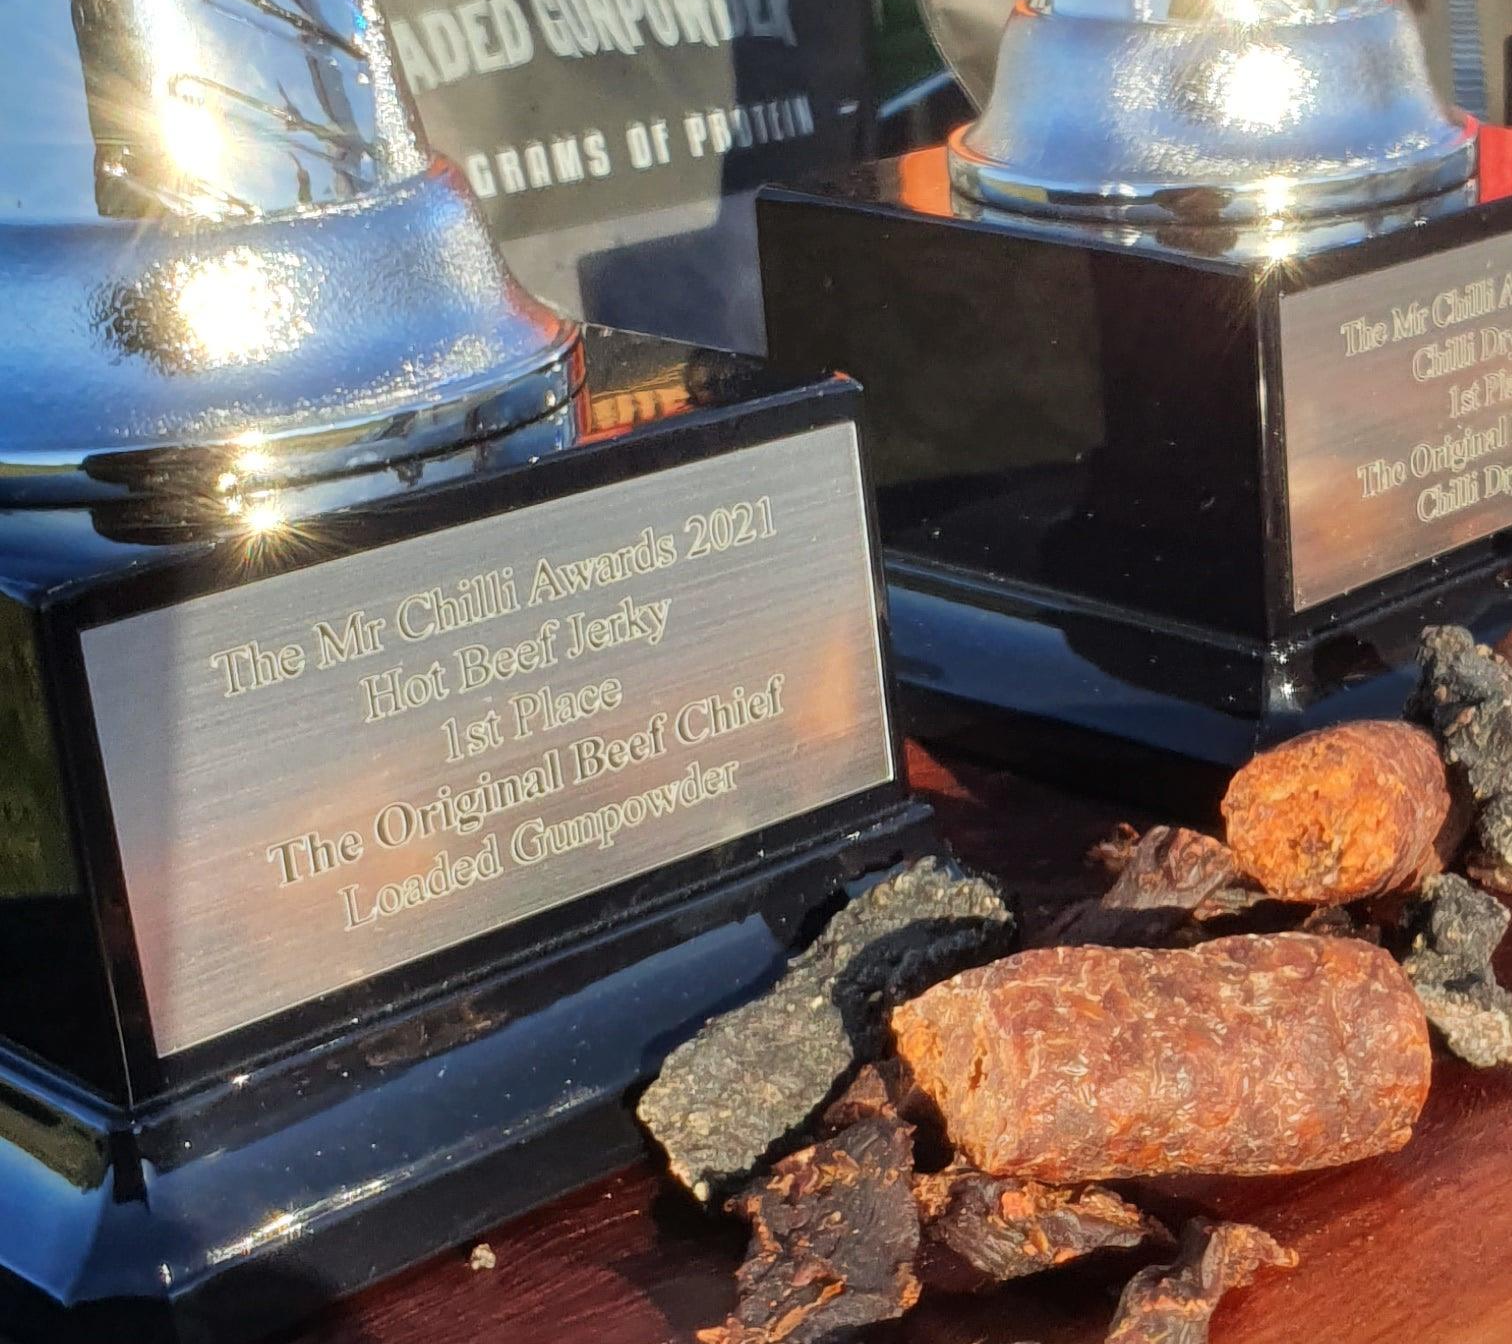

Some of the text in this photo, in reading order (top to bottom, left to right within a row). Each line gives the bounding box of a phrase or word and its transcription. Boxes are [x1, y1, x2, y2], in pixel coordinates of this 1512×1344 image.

[464, 128, 613, 199] GRAMS
[625, 118, 671, 171] OF
[1340, 316, 1388, 357] The
[1391, 301, 1430, 342] Mr
[1431, 277, 1497, 329] Chilli
[1412, 331, 1477, 382] Chilli
[1448, 379, 1482, 419] 1st
[1357, 458, 1408, 499] The
[1410, 417, 1508, 478] Original
[1416, 472, 1480, 523] Chilli
[211, 495, 778, 698] The Mr Chilli Awards 2021
[359, 595, 673, 724] Hot Beef Jerky
[440, 677, 623, 764] 1st Place
[266, 673, 786, 889] The Original Beef Chief
[337, 760, 740, 932] Loaded Gunpowder
